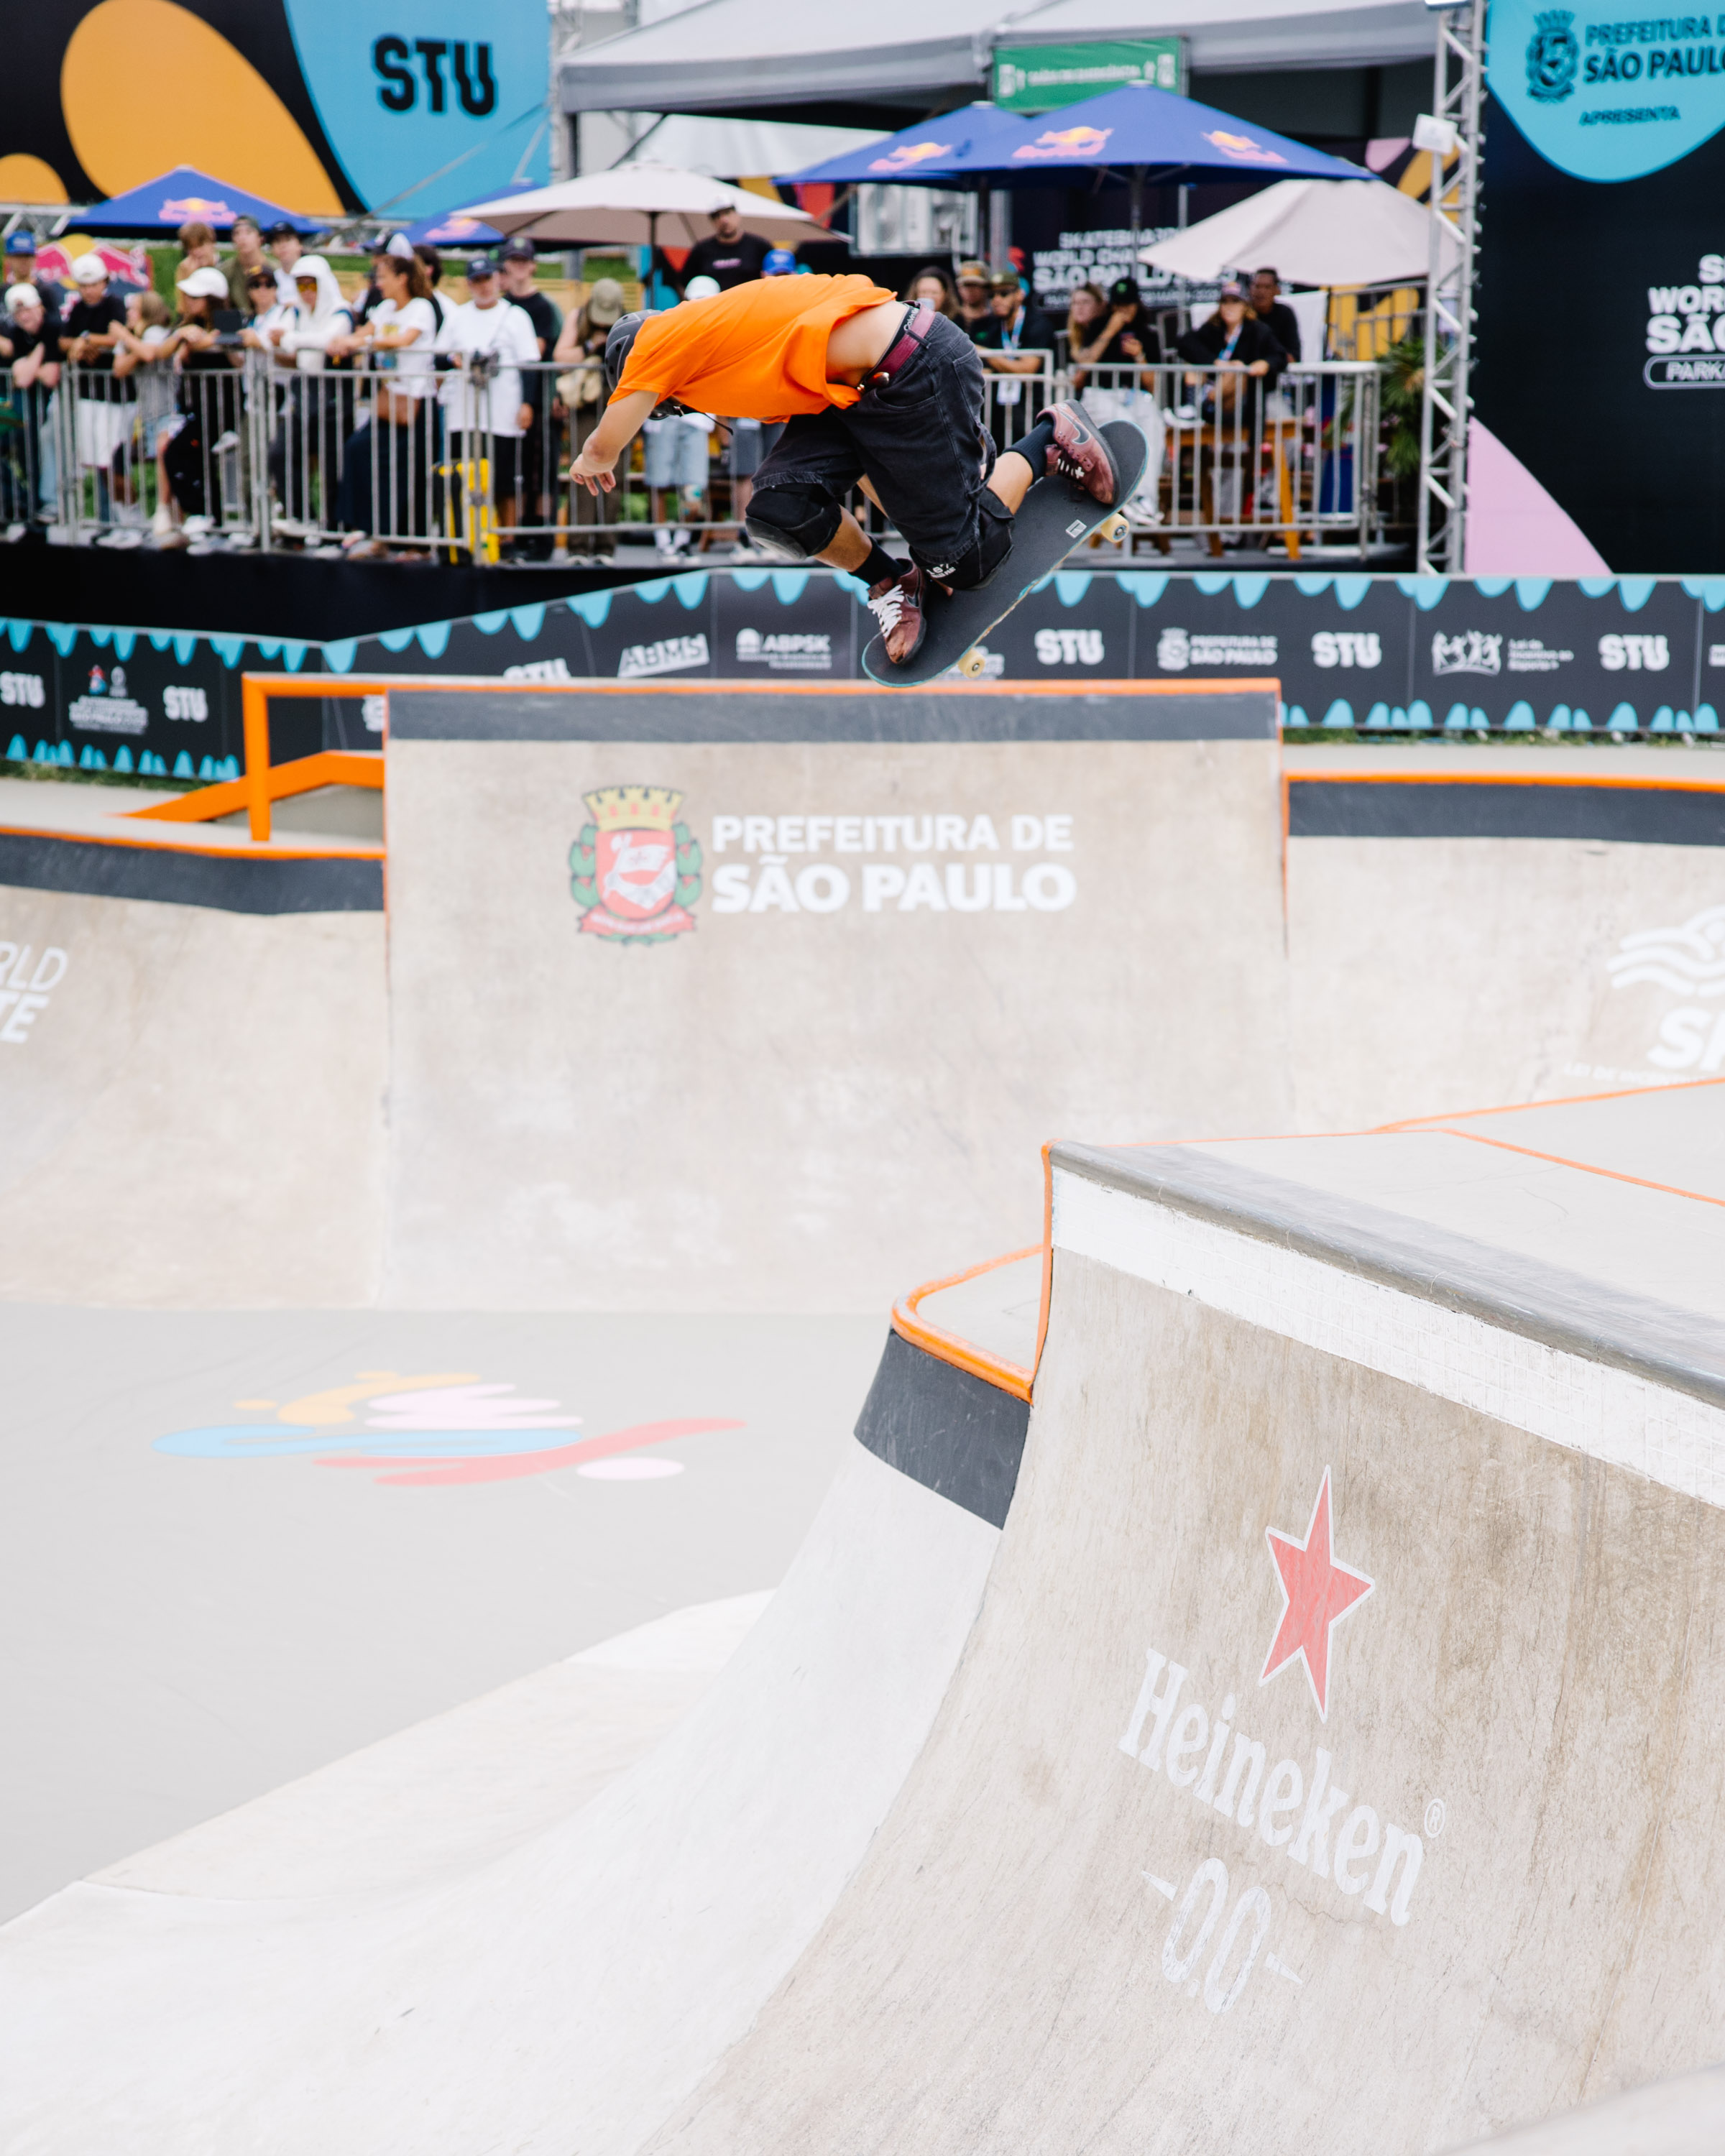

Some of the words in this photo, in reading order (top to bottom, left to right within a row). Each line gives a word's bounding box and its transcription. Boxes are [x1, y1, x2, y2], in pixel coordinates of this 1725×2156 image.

[1585, 16, 1712, 46] PREFEITURA
[372, 34, 497, 118] STU
[1583, 47, 1643, 84] SÃO
[1579, 106, 1680, 126] APRESENTA
[1647, 285, 1725, 315] WOR
[1034, 628, 1105, 665] STU
[1311, 631, 1382, 668] STU
[1598, 633, 1670, 671] STU
[0, 671, 45, 709] STU
[163, 685, 208, 722] STU
[712, 814, 1000, 853] PREFEITURA
[1011, 814, 1075, 852] DE
[711, 853, 851, 913] SÃO
[862, 862, 1077, 913] PAULO
[1118, 1648, 1425, 1927] Heineken
